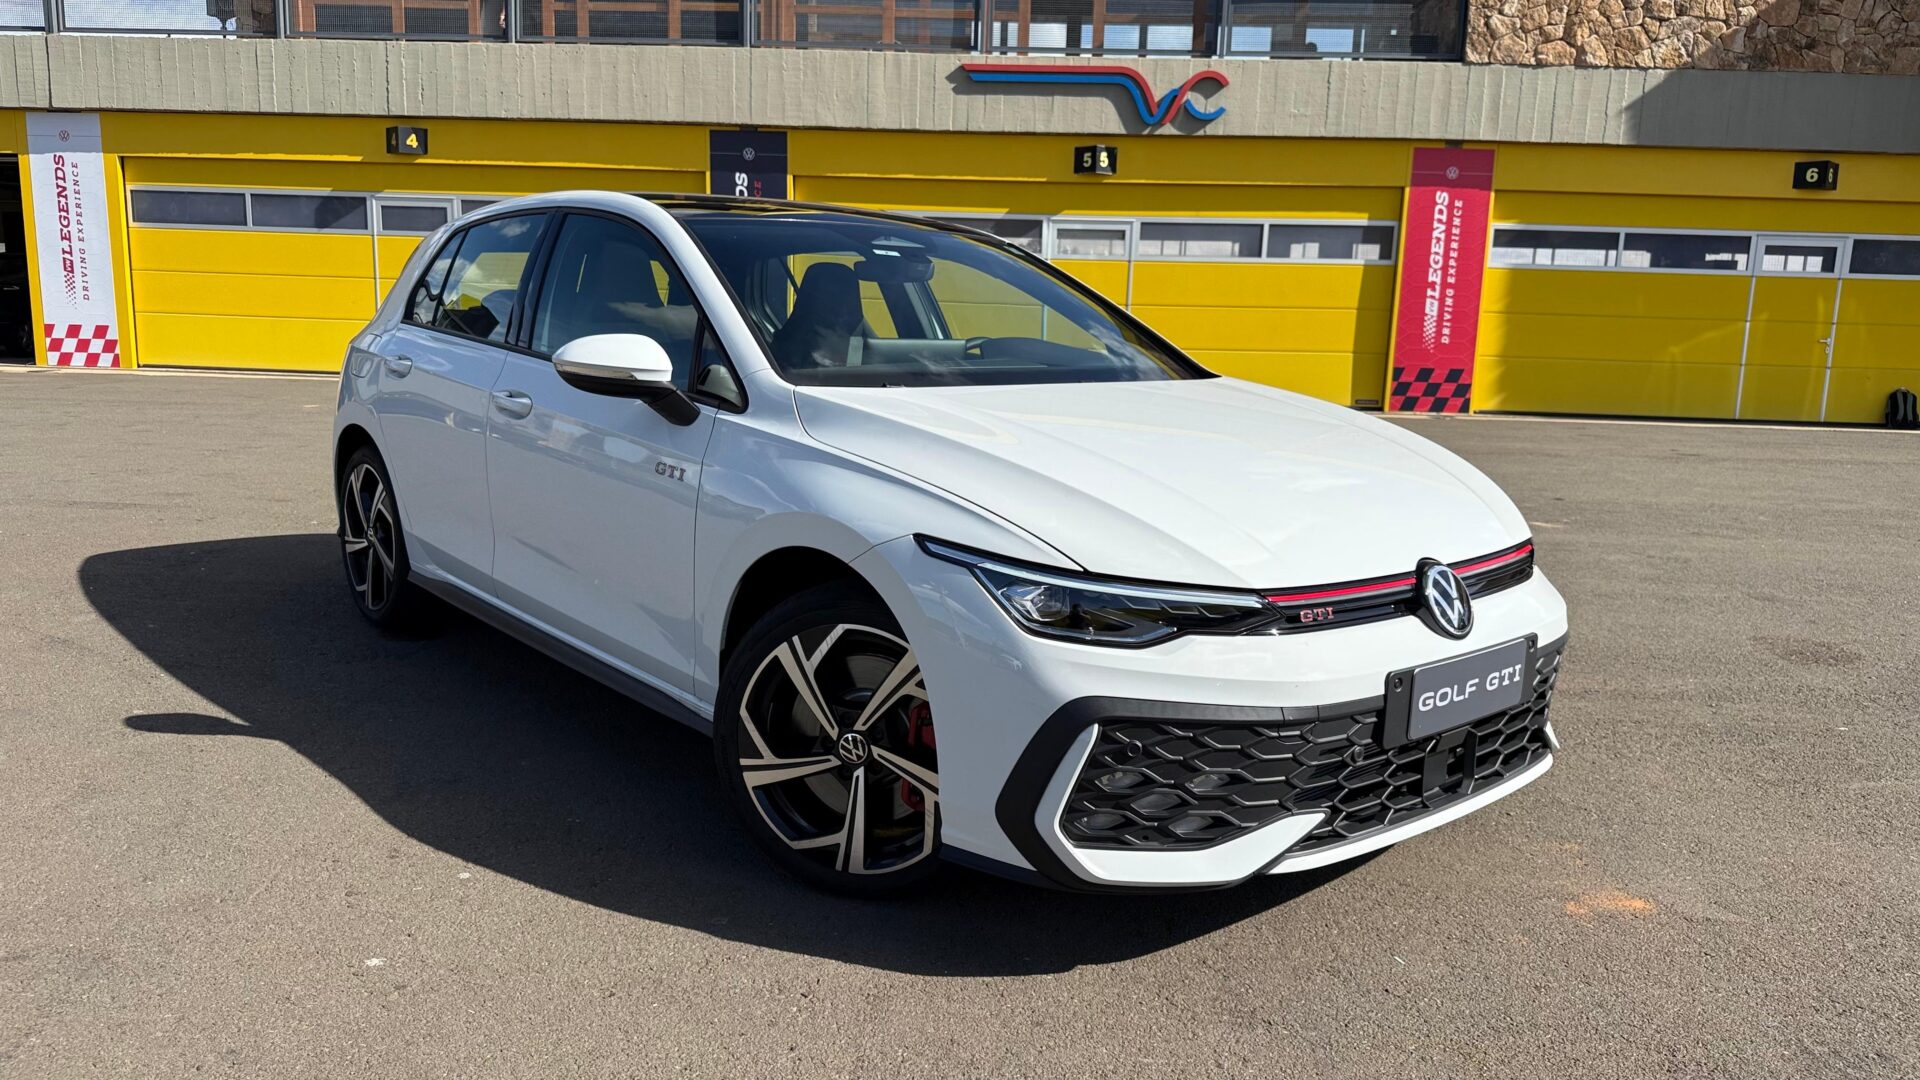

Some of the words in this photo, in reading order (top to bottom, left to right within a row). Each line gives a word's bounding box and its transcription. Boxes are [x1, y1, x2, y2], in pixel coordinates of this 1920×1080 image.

[406, 133, 418, 149] 4
[1082, 152, 1092, 168] 5
[1099, 151, 1109, 168] 5
[1805, 167, 1819, 183] 6
[1828, 167, 1834, 183] 6
[53, 153, 74, 258] LEGENDS
[71, 161, 85, 243] EXPERIENCE
[1426, 190, 1449, 299] LEGENDS
[1446, 199, 1463, 284] EXPERIENCE
[78, 247, 90, 301] DRIVING
[1441, 288, 1455, 345] DRIVING
[655, 461, 687, 482] GTI
[1299, 606, 1335, 624] GTI
[1418, 678, 1479, 712] GOLF
[1485, 663, 1523, 692] GTI
